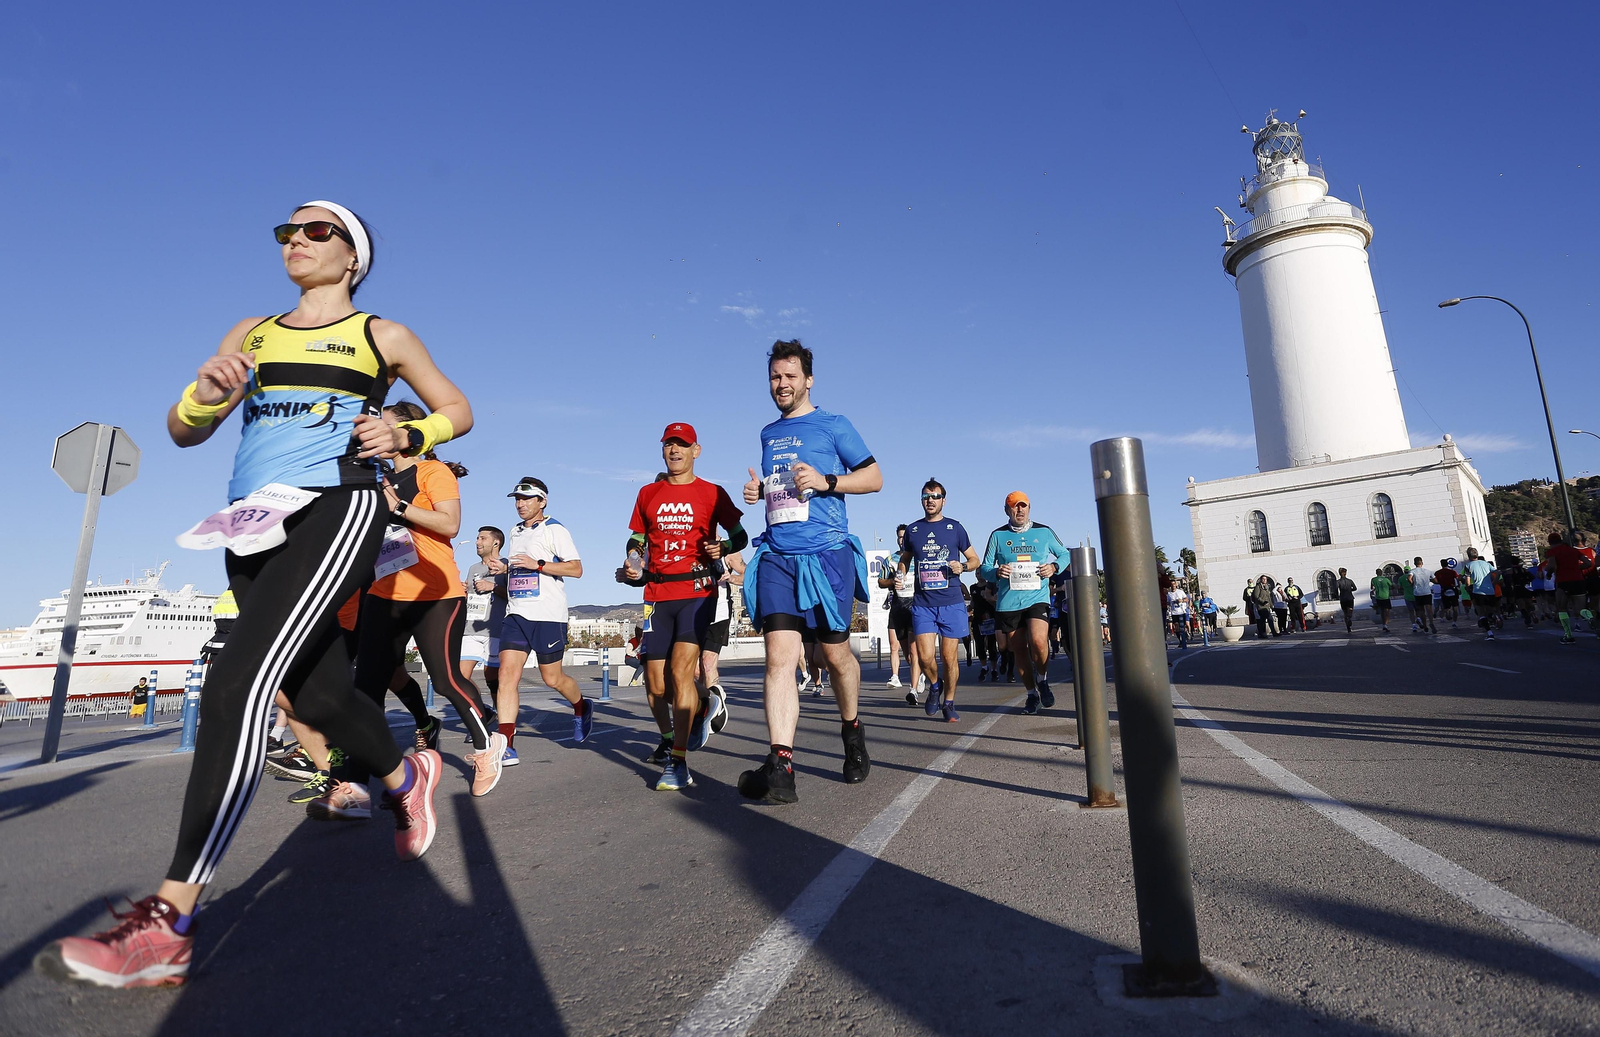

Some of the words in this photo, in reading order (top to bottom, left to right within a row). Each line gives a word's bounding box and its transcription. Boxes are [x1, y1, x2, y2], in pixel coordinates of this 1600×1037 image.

[254, 490, 300, 502] ZURICH
[773, 491, 792, 502] 6649
[656, 514, 694, 523] MARATÓN
[381, 541, 400, 555] 6648
[1010, 545, 1037, 554] MENDOZA
